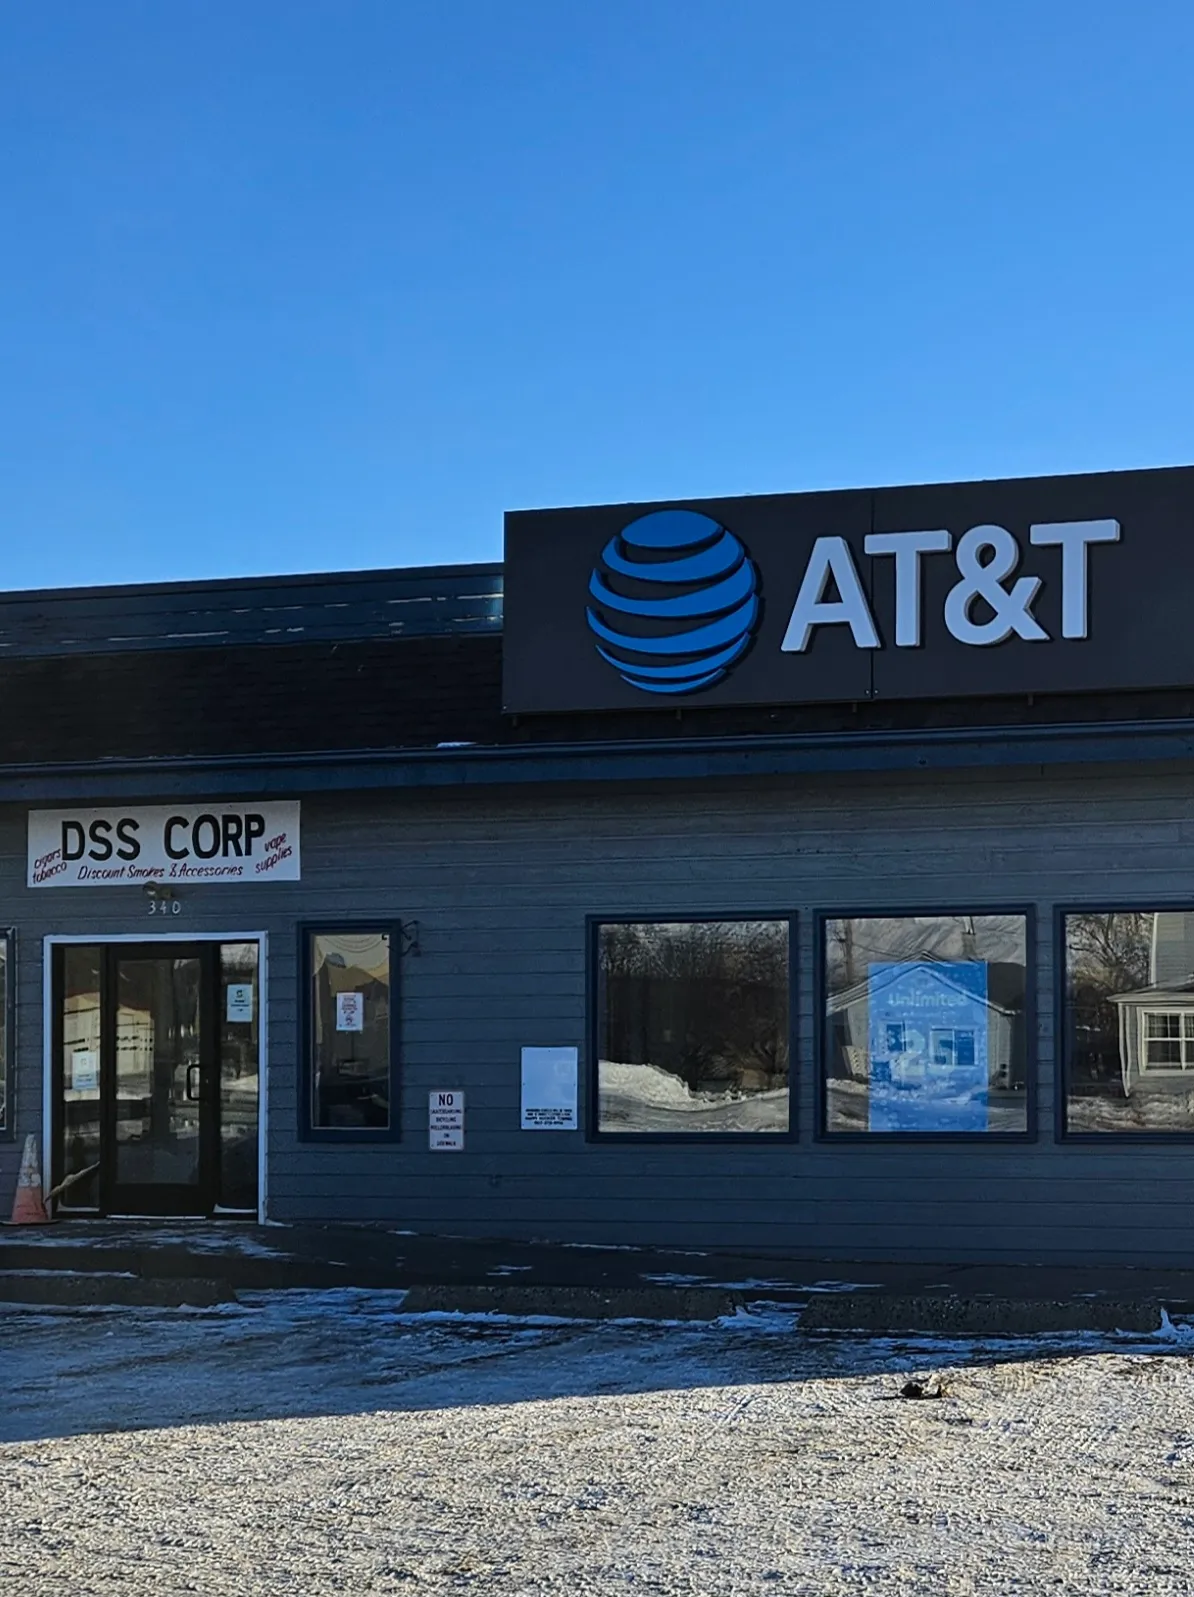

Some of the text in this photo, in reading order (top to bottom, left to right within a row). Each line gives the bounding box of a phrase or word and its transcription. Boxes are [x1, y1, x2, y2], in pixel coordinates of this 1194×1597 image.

[781, 518, 1120, 652] AT&T
[61, 814, 265, 861] DSS CORP
[264, 832, 287, 852] vape
[34, 848, 62, 870] cigars
[255, 845, 292, 874] supplies
[32, 861, 67, 885] tobacco
[77, 864, 125, 880] Discount
[127, 864, 165, 878] Smokes
[147, 900, 182, 915] 340
[888, 988, 968, 1007] Unlimited
[438, 1093, 454, 1106] NO
